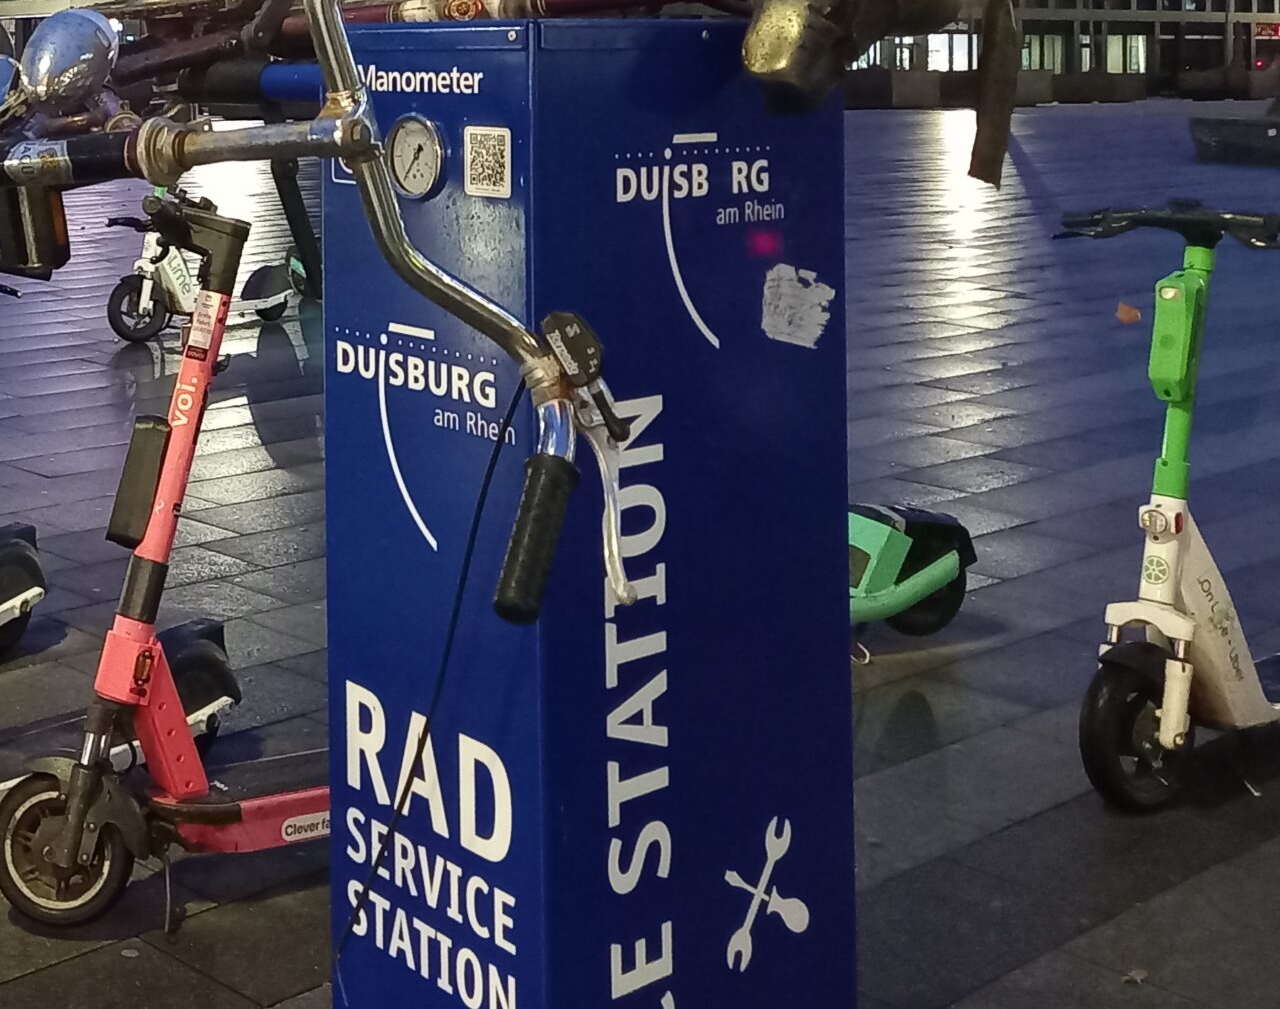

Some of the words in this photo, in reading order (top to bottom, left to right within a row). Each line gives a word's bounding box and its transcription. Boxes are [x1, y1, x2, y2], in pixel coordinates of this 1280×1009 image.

[357, 64, 483, 94] Manometer
[716, 207, 740, 225] am
[744, 199, 785, 223] Rhein
[167, 254, 192, 295] Lime
[336, 339, 497, 409] DUISBURG
[434, 408, 459, 431] am
[601, 394, 671, 895] STATION
[345, 678, 513, 863] RAD
[284, 821, 321, 837] Clever
[346, 806, 517, 956] SERVICE
[347, 879, 517, 1009] STATION
